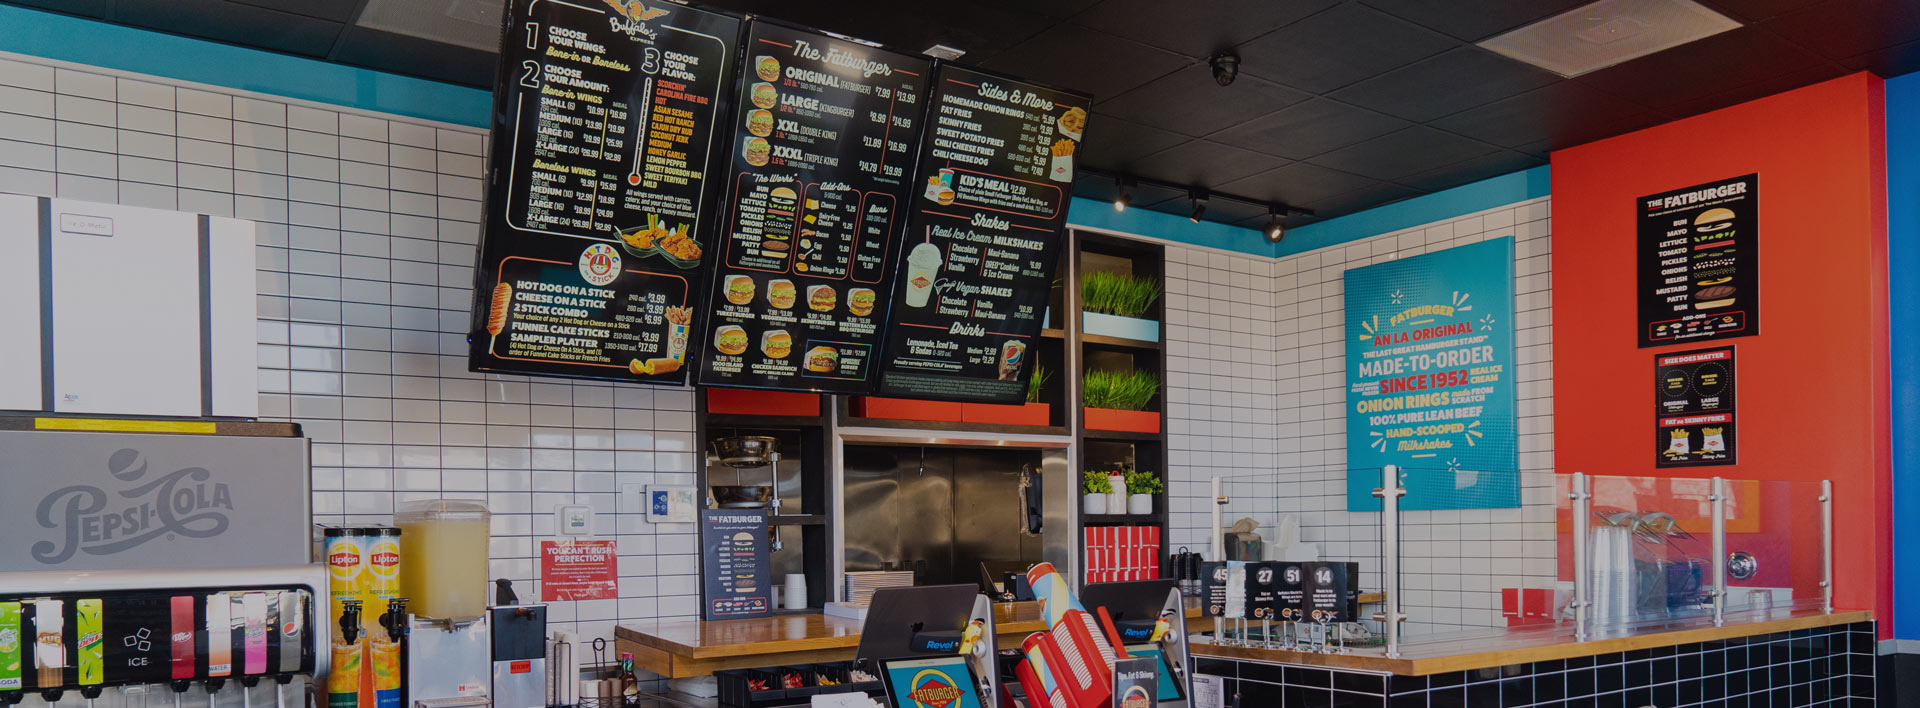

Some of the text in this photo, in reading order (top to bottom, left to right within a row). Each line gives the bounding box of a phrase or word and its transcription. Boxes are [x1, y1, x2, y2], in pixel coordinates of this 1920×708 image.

[549, 26, 587, 41] CHOOSE
[609, 17, 657, 40] Buffalo's
[548, 34, 606, 54] YOUR WINGS:
[592, 55, 631, 72] Boneless
[641, 47, 660, 74] 3
[664, 51, 699, 65] CHOOSE
[793, 39, 891, 78] The Fatburger
[544, 64, 582, 78] CHOOSE
[664, 59, 686, 71] YOUR
[662, 68, 696, 81] FLAVOR:
[544, 73, 610, 93] YOUR AMOUNT:
[785, 66, 915, 104] ORIGINAL $7.99 $13.99
[541, 97, 566, 109] SMALL
[577, 92, 602, 104] WINGS
[781, 93, 819, 111] LARGE
[978, 82, 1054, 111] Sides & More
[941, 105, 972, 119] FAT FRIES
[943, 94, 1025, 118] HOMEMADE ONION RINGS
[539, 112, 571, 124] MEDIUM
[939, 116, 982, 132] SKINNY FRIES
[538, 126, 562, 137] LARGE
[777, 119, 800, 133] XXL
[937, 127, 1005, 148] SWEET POTATO FRIES
[773, 145, 803, 161] XXXL
[952, 141, 995, 157] CHEESE FRIES
[666, 158, 687, 168] PEPPER
[950, 151, 989, 166] CHEESE DOG
[532, 171, 557, 182] SMALL
[571, 166, 596, 177] WINGS
[531, 185, 562, 197] MEDIUM
[756, 185, 769, 193] BUN
[959, 175, 1027, 195] KID'S MEAL $12.99
[1647, 199, 1663, 208] THE
[1665, 182, 1747, 208] FATBURGER
[529, 199, 553, 209] LARGE
[740, 204, 765, 213] TOMATO
[741, 198, 766, 207] LETTUCE
[741, 212, 764, 220] PICKLES
[971, 213, 1010, 231] Shakes
[740, 219, 763, 228] ONIONS
[1673, 219, 1687, 227] BUN
[733, 232, 761, 241] MUSTARD
[931, 225, 1044, 251] Real Cream MILKSHAKES
[1667, 228, 1687, 237] MAYO
[952, 243, 978, 255] Chocolate
[1660, 238, 1687, 248] LETTUCE
[1658, 247, 1688, 258] TOMATO
[950, 253, 980, 266] Strawberry
[1662, 257, 1688, 266] PICKLES
[1661, 266, 1688, 276] ONIONS
[1665, 275, 1688, 285] RELISH
[516, 280, 539, 290] HOT
[540, 282, 562, 293] DOG
[563, 285, 579, 295] ON
[588, 288, 615, 298] STICK
[980, 285, 1013, 298] SHAKES
[1656, 285, 1688, 295] MUSTARD
[515, 292, 606, 309] CHEESE ON A STICK
[1666, 294, 1688, 303] PATTY
[522, 304, 588, 318] STICK COMBO
[1390, 304, 1455, 327] FATBURGER
[512, 322, 610, 338] FUNNEL CAKE STICKS
[949, 321, 985, 337] Drinks
[1374, 321, 1473, 347] AN LA ORIGINAL
[511, 333, 598, 348] SAMPLER PLATTER
[1375, 348, 1393, 358] LAST
[1392, 346, 1415, 356] GREAT
[1415, 340, 1460, 352] HAMBURGER
[1359, 345, 1494, 378] MADE-TO-ORDER
[1697, 352, 1724, 361] MATTER
[1470, 364, 1502, 376] REAL ICE
[1380, 373, 1428, 394] SINCE
[1430, 369, 1468, 388] 1952
[1470, 374, 1498, 384] CREAM
[1471, 387, 1494, 395] FROM
[1357, 391, 1450, 414] ONION RINGS
[1452, 394, 1485, 404] SCRATCH
[1370, 406, 1483, 426] 100% PURE LEAN BEEF
[1386, 422, 1465, 438] HAND-SCOOPED
[1397, 438, 1453, 452] Milkshakes
[331, 556, 358, 564] Lipton
[374, 555, 398, 563] Lipton
[1213, 569, 1227, 581] 45
[1258, 570, 1273, 582] 27
[1287, 569, 1300, 582] 51
[1316, 570, 1331, 583] 14
[1125, 628, 1149, 636] Revel
[926, 640, 954, 649] Revel
[128, 657, 148, 667] ICE
[209, 664, 228, 672] WATER
[913, 686, 960, 701] FATBURGER
